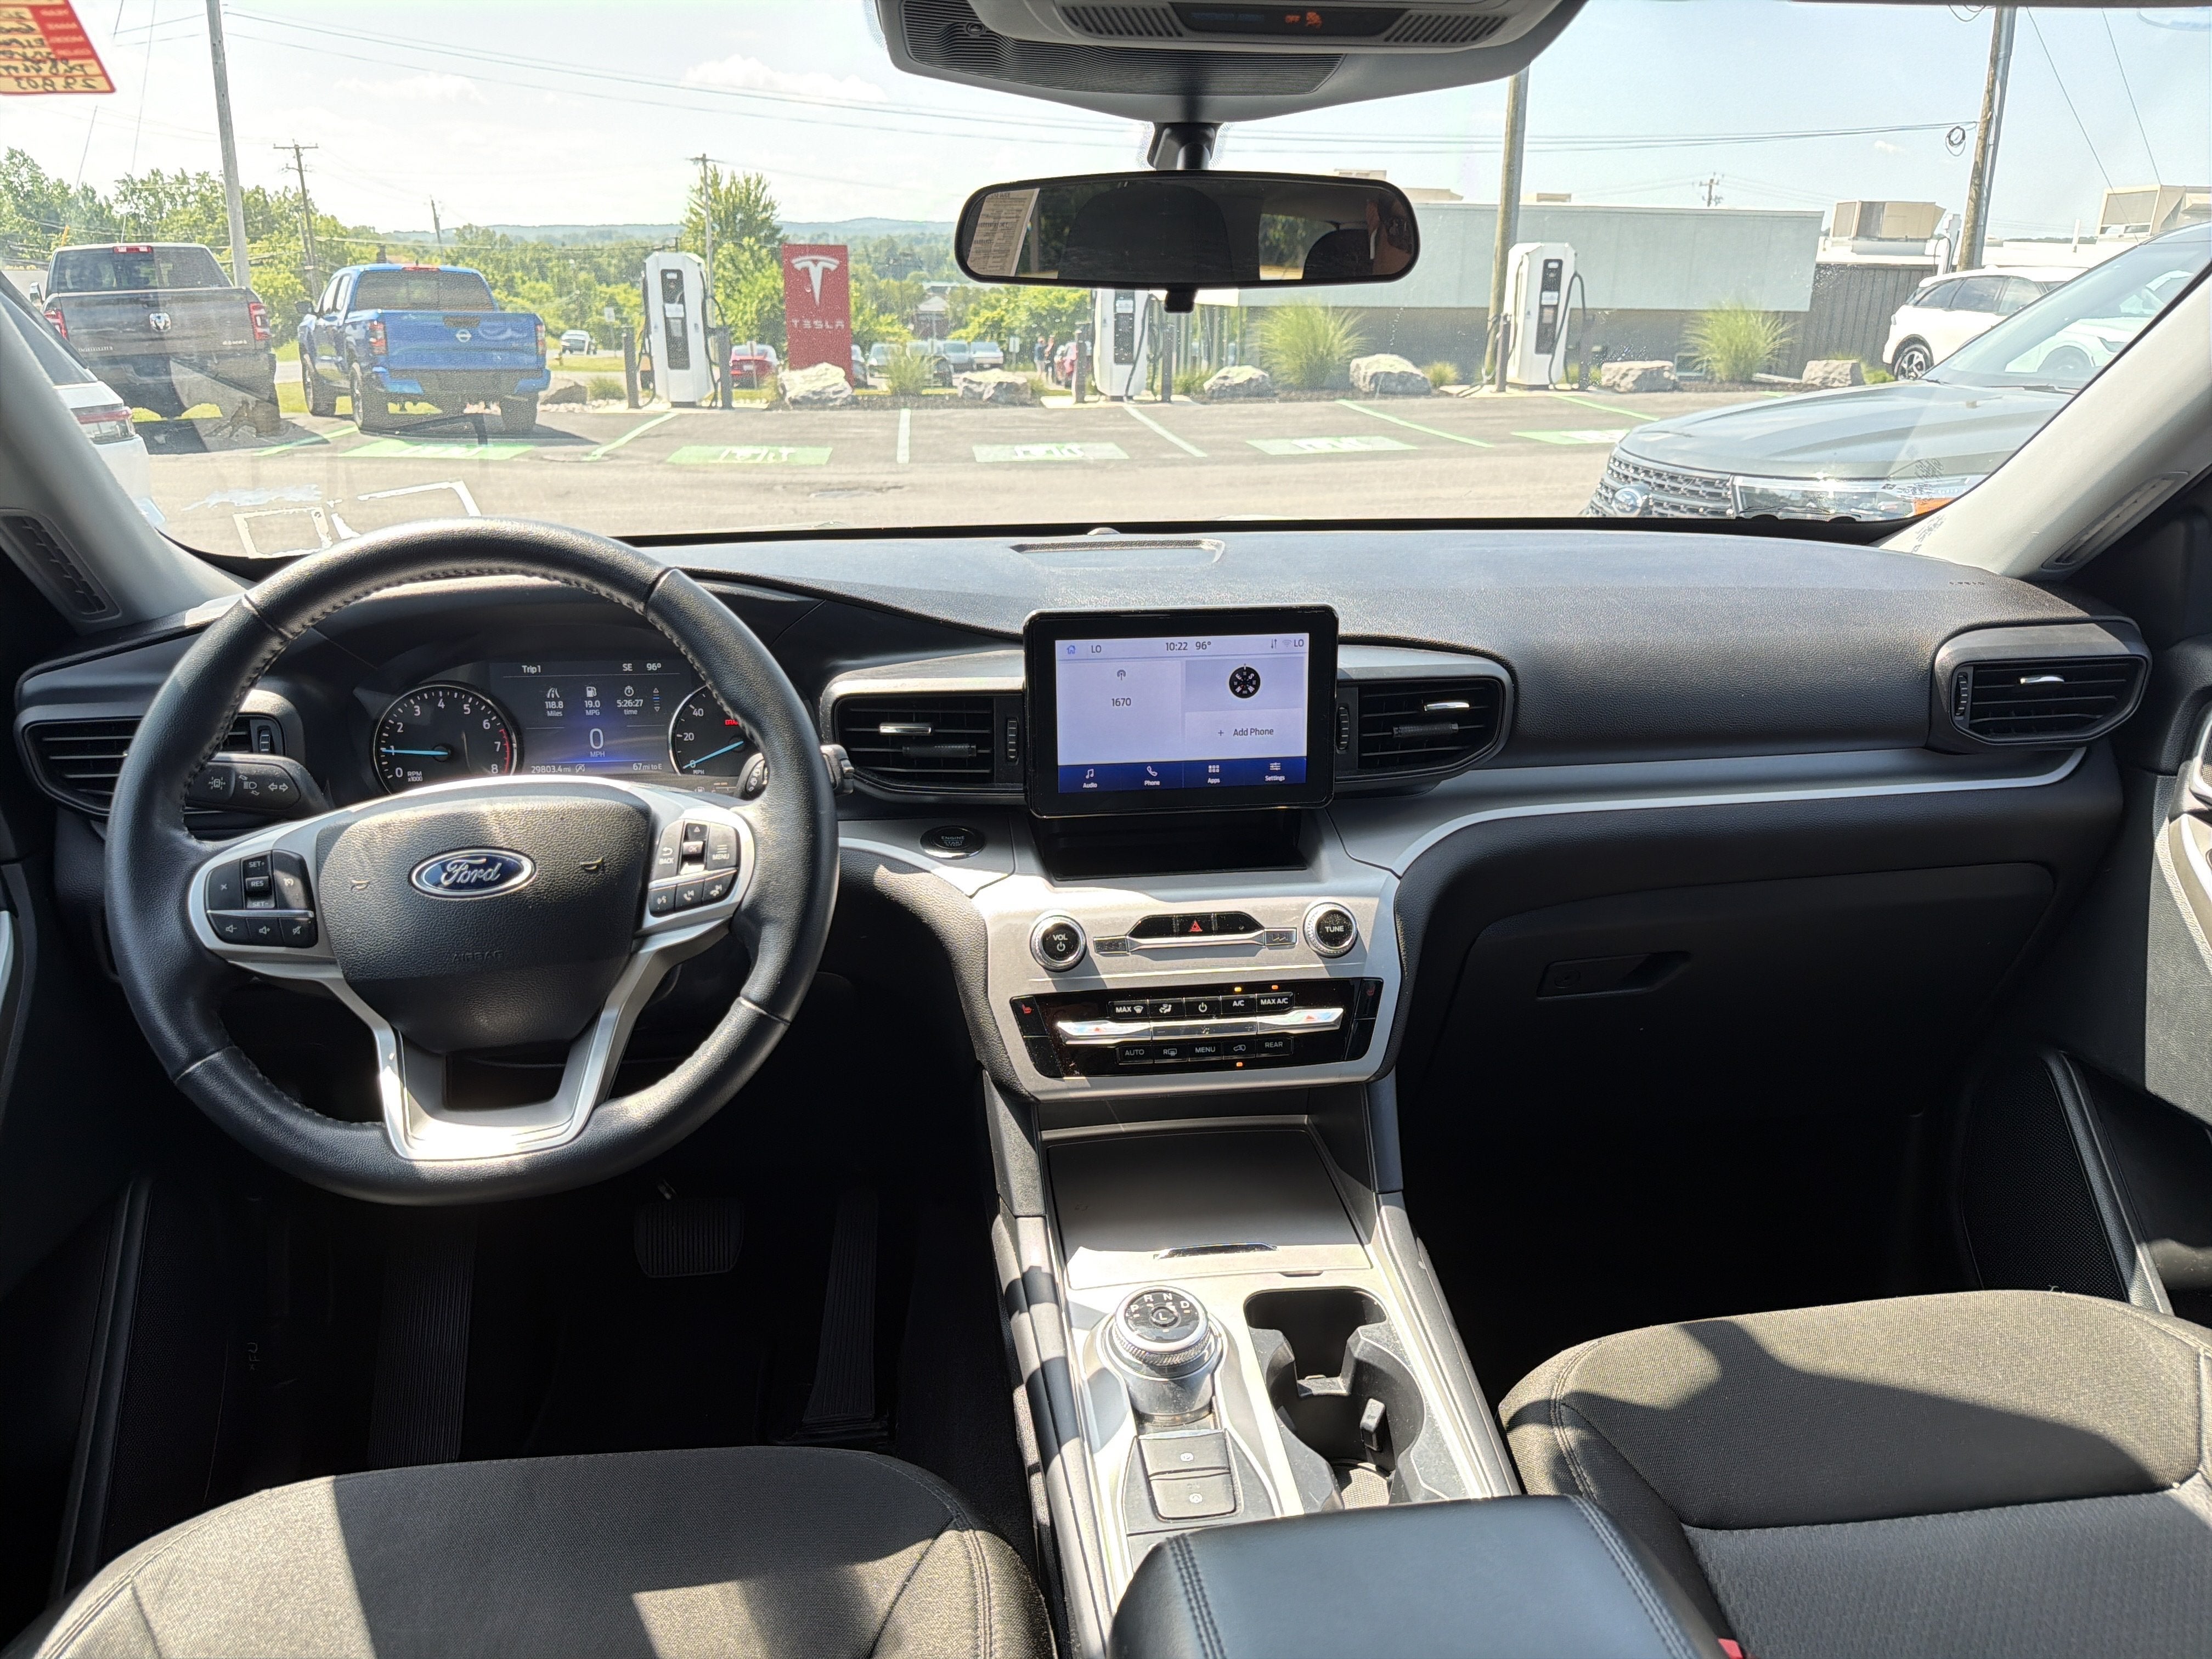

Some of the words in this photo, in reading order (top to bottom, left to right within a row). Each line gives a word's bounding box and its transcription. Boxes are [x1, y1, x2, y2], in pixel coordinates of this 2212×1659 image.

[792, 319, 845, 329] TESLA
[1165, 642, 1188, 651] 10:22
[1195, 641, 1211, 650] 96°
[1294, 639, 1304, 647] LO
[1091, 645, 1102, 653] LO
[623, 663, 633, 672] SE
[438, 698, 445, 709] 4
[545, 701, 564, 709] 118.8
[617, 699, 644, 708] 5:26:27
[1111, 698, 1131, 707] 1670
[414, 705, 421, 716] 3
[463, 704, 471, 714] 5
[692, 708, 704, 716] 40
[397, 722, 404, 733] 2
[483, 719, 490, 730] 6
[1233, 728, 1249, 736] Add
[1250, 727, 1274, 736] Phone
[589, 728, 604, 749] 0
[683, 732, 695, 741] 20
[390, 746, 395, 755] 1
[494, 741, 501, 752] 7
[633, 763, 642, 771] 67
[690, 760, 696, 768] 0
[395, 768, 403, 778] 0
[491, 764, 498, 774] 8
[531, 764, 563, 774] 29803.4
[441, 857, 502, 887] Ford
[1163, 1293, 1173, 1301] N
[1130, 1304, 1139, 1313] P
[1180, 1300, 1190, 1308] D
[1159, 1312, 1168, 1321] L
